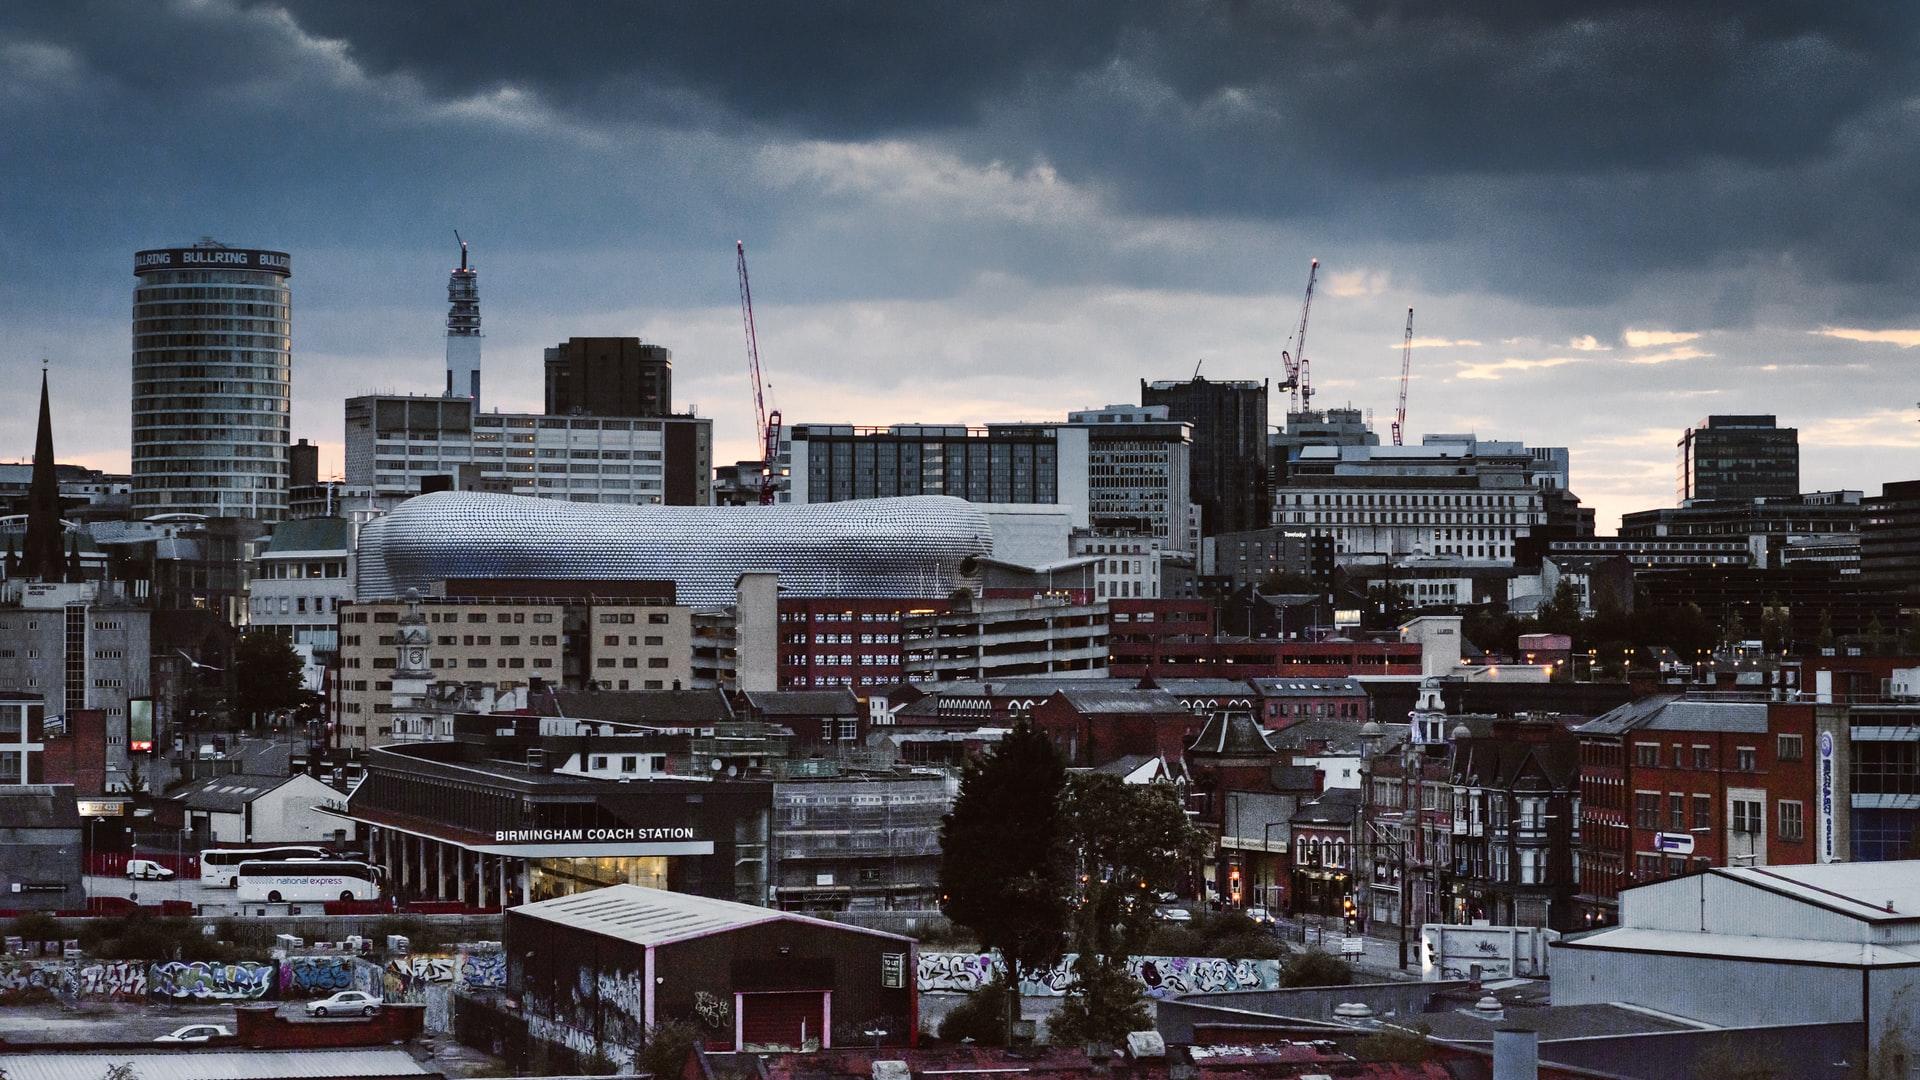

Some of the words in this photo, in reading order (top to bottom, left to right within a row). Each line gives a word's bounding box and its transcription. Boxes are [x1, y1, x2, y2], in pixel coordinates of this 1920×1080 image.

[183, 252, 248, 264] BULLRING
[495, 829, 583, 841] BIRMINGHAM
[587, 829, 634, 840] COACH
[638, 828, 694, 839] STATION
[276, 877, 309, 885] national
[309, 878, 343, 886] express
